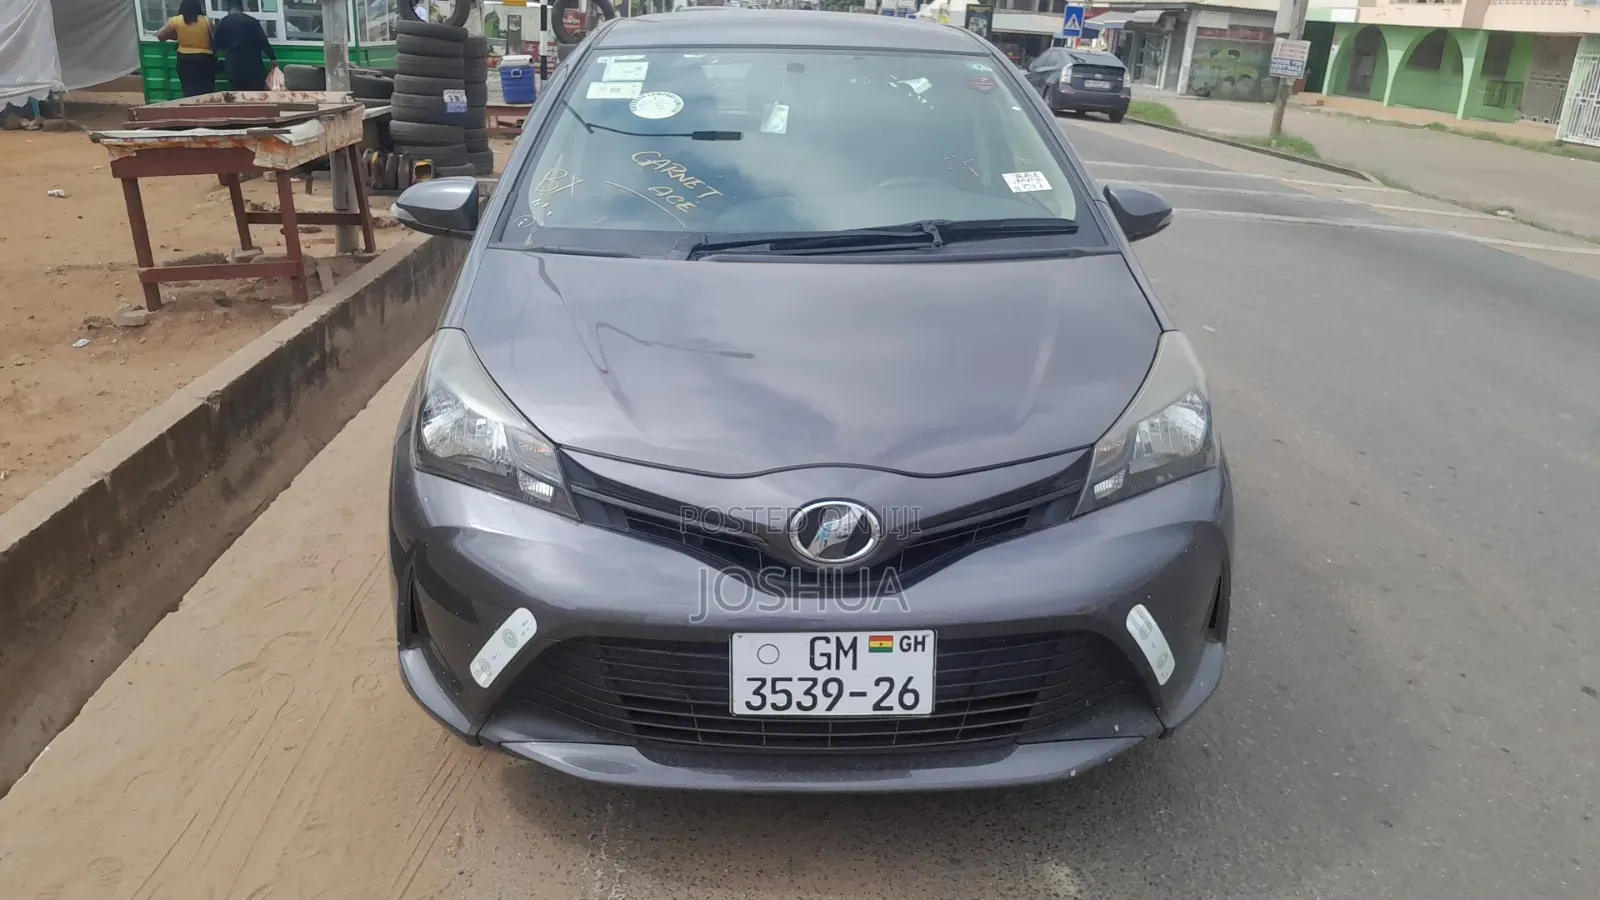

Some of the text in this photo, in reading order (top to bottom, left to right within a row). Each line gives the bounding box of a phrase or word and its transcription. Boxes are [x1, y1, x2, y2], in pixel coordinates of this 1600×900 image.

[631, 151, 723, 199] GARNET
[648, 186, 696, 213] ACE
[809, 635, 926, 671] GM GH
[745, 676, 920, 712] 3539-26
